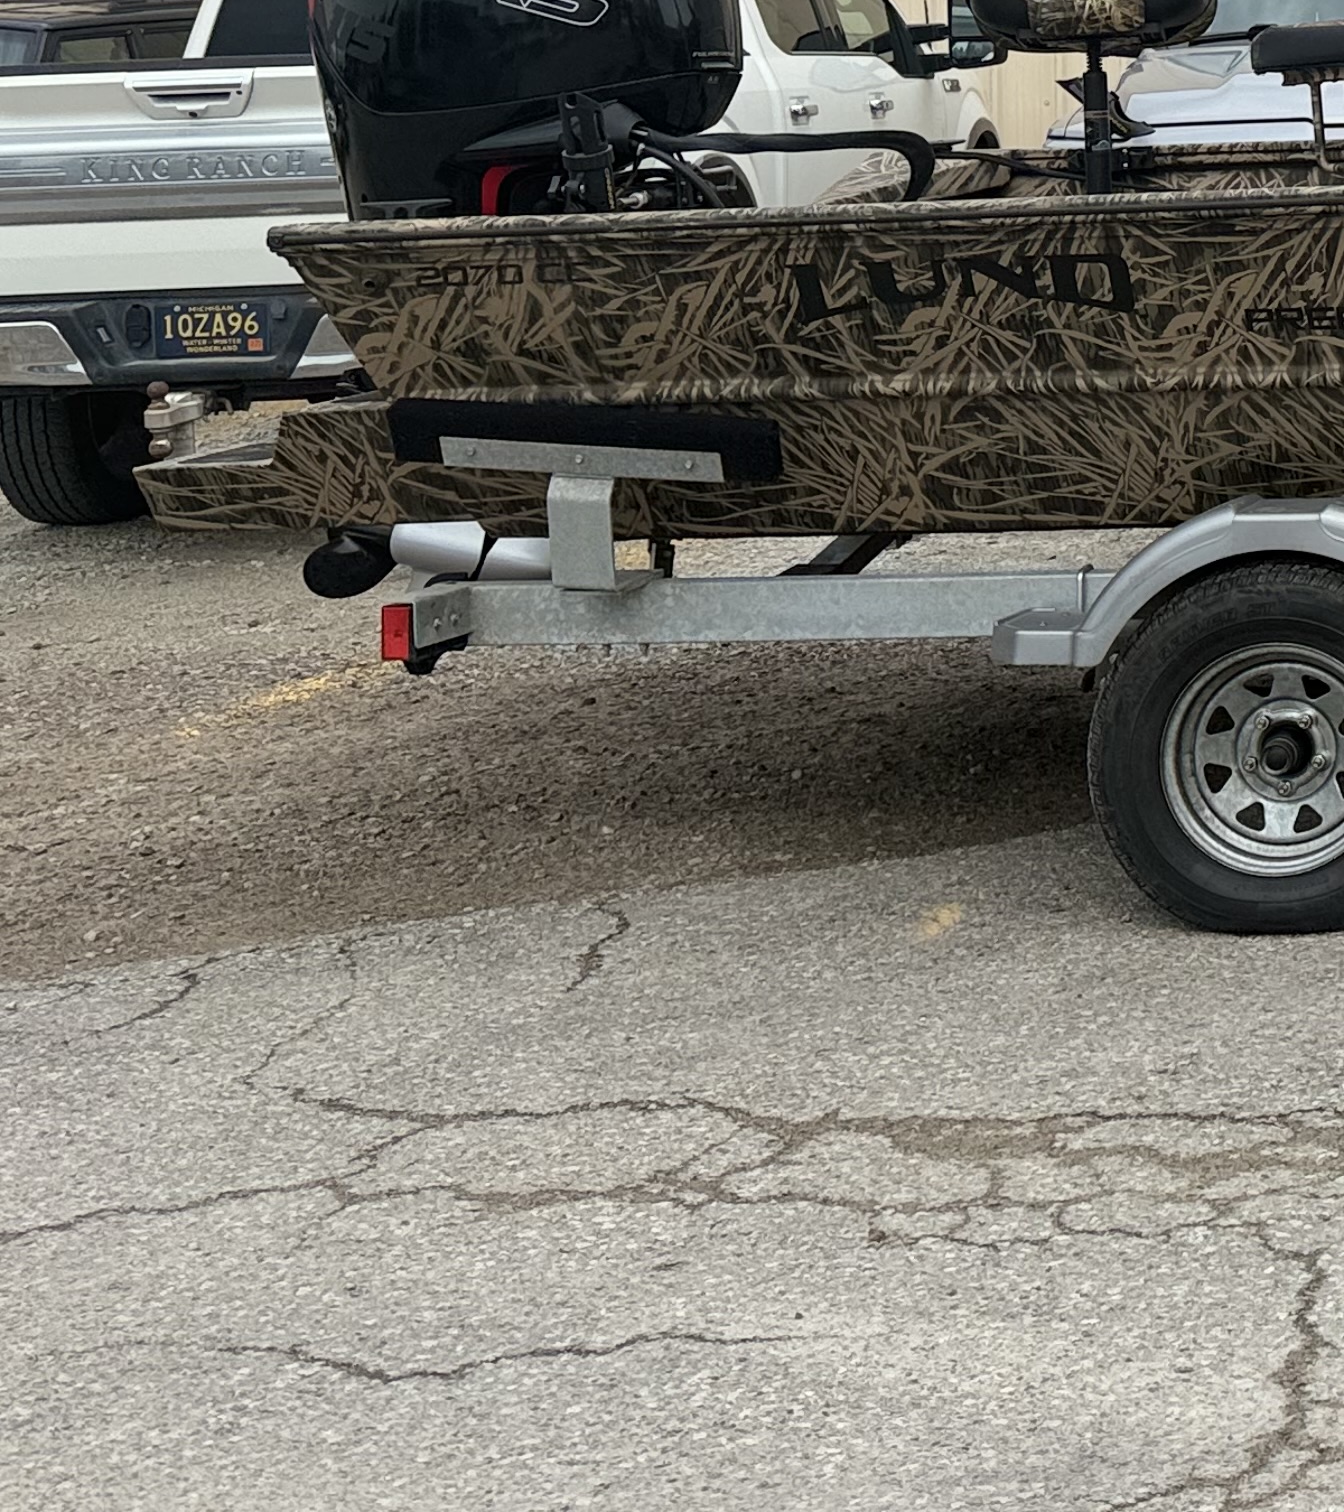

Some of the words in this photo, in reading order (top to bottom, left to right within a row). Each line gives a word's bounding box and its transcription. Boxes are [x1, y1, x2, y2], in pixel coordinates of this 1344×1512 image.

[79, 156, 170, 183] KING
[186, 149, 306, 180] RANCH
[416, 263, 524, 287] 2070
[785, 254, 1136, 324] LUND
[187, 305, 234, 313] MICHIGAN
[186, 345, 238, 353] WONDERLAND
